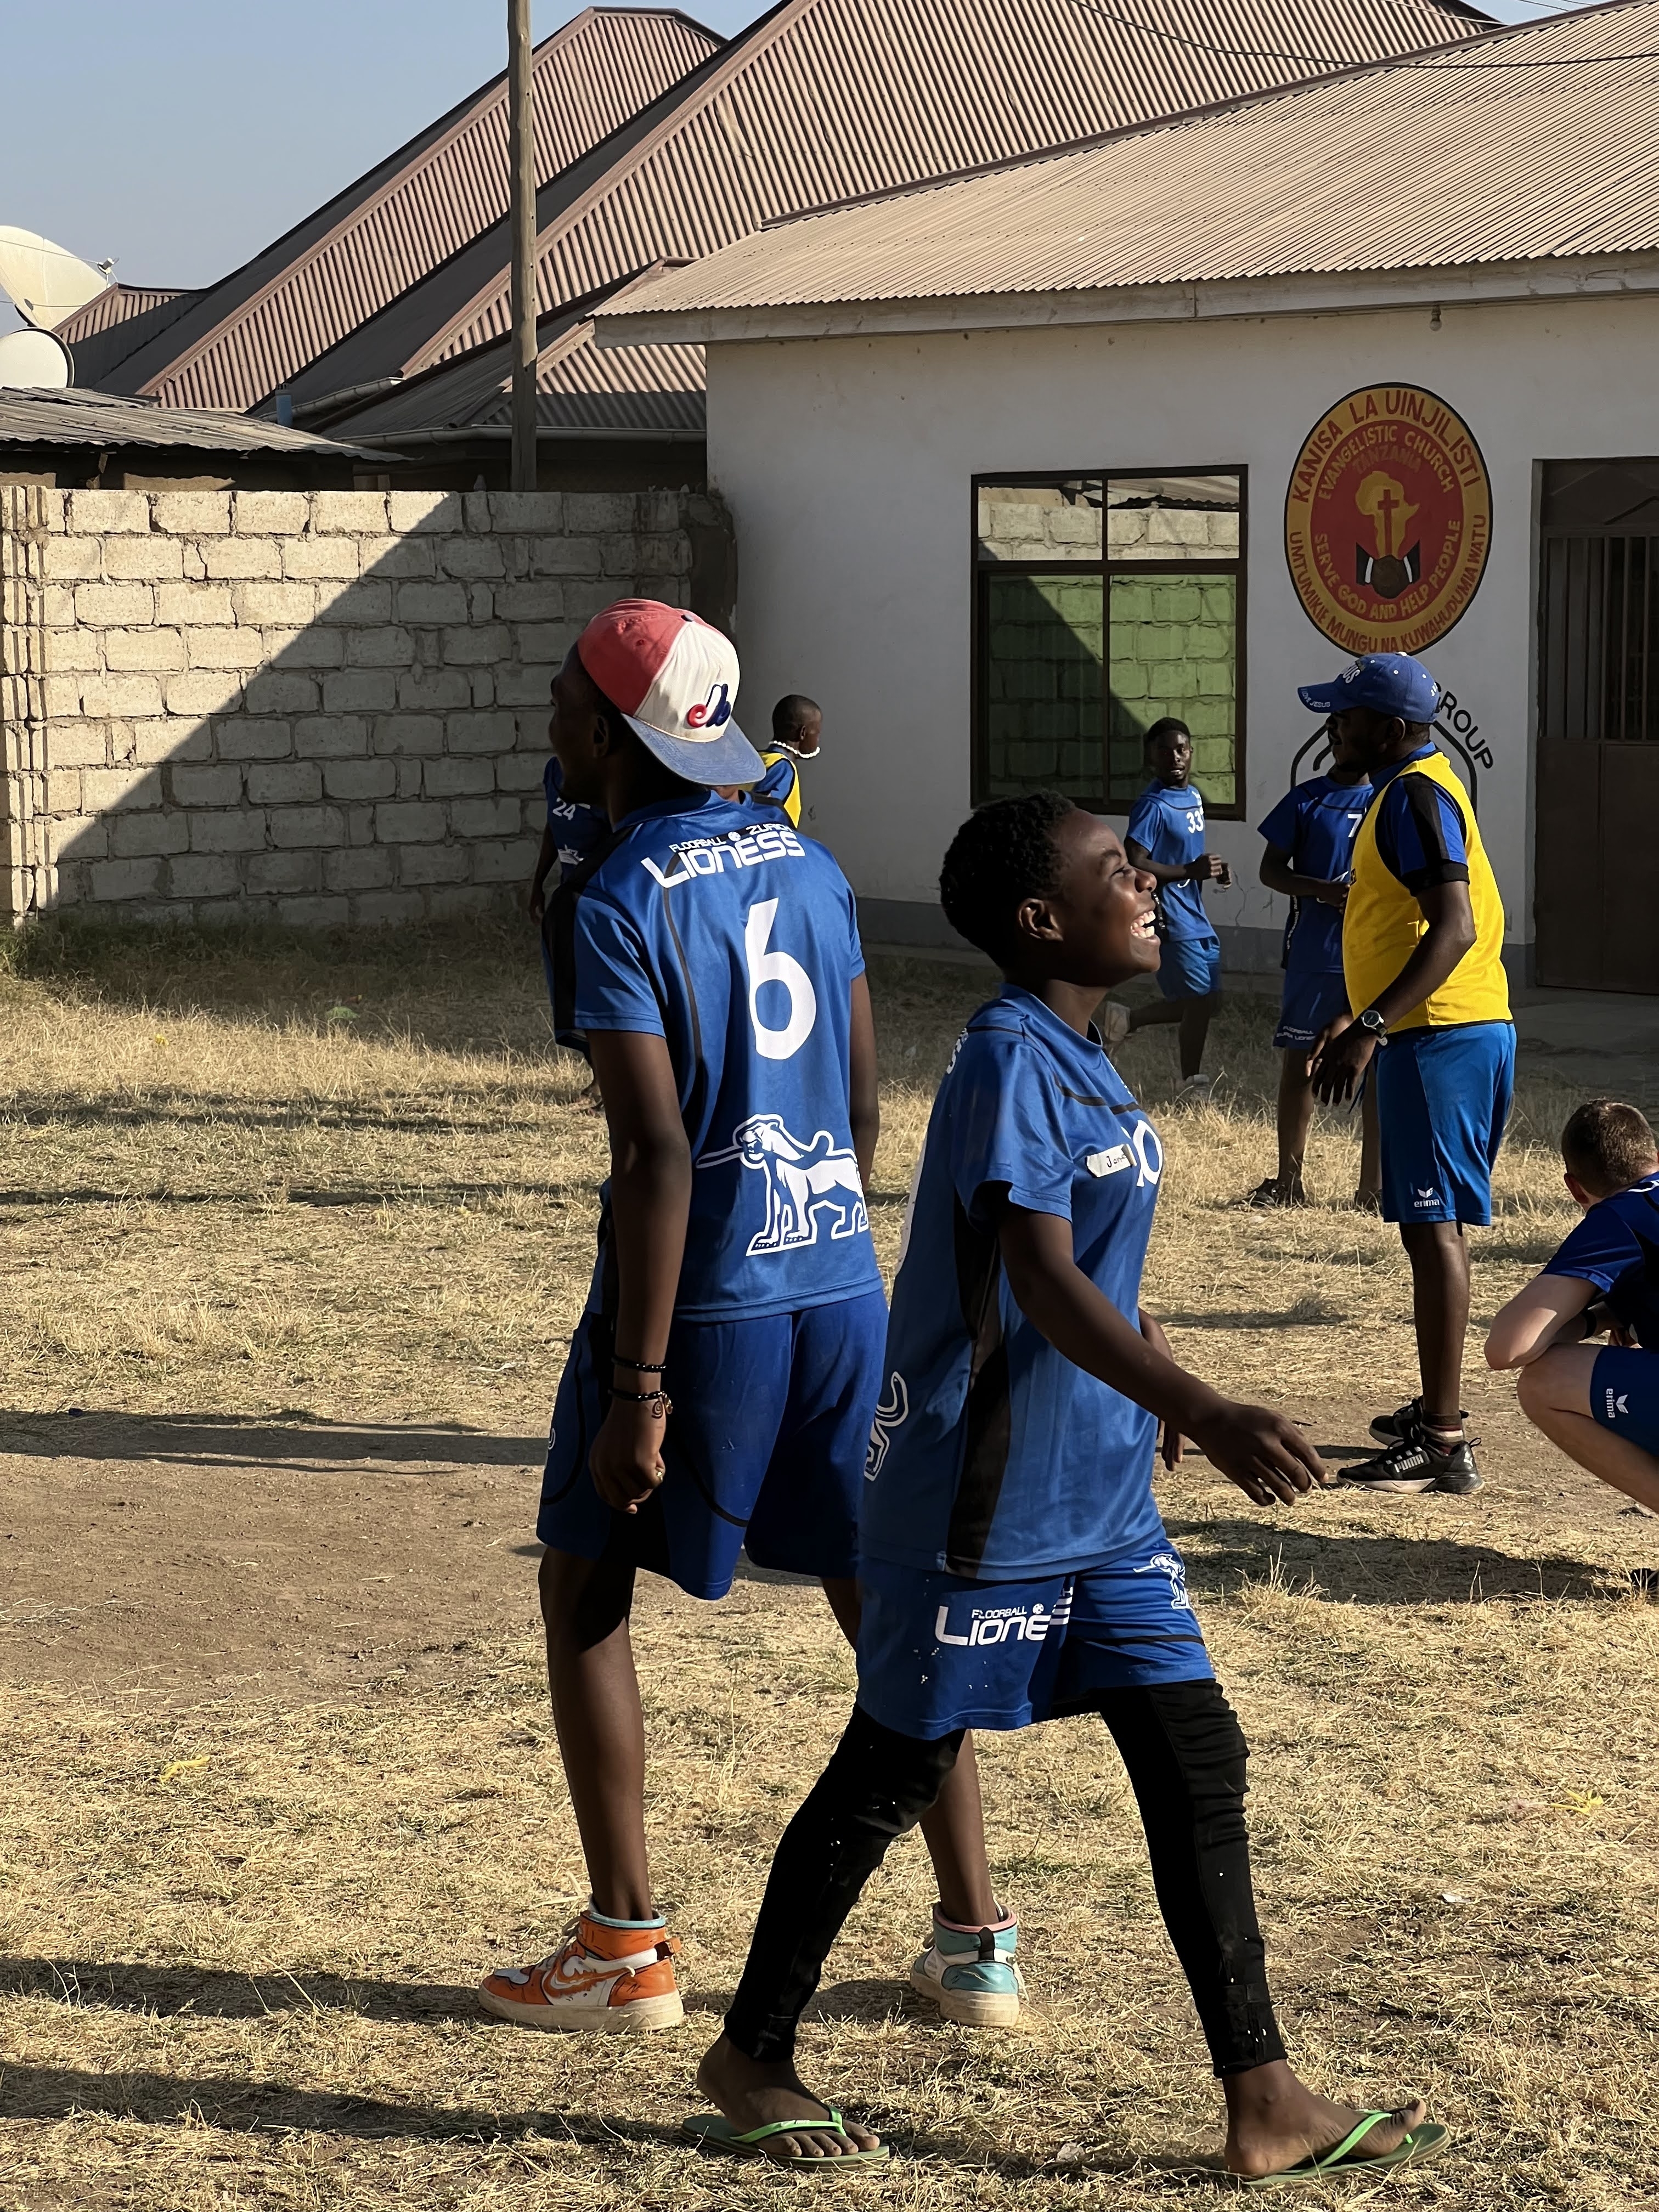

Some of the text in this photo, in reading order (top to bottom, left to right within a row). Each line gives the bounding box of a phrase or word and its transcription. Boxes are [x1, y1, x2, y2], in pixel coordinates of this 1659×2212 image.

[1293, 390, 1481, 503] KANISA LA UINJILISTI
[1318, 426, 1454, 500] EVANGELISTIC CHURCH
[1315, 520, 1460, 619] SERVE GOD AND HELP PEOPLE
[1326, 616, 1377, 653] MUNGU
[1381, 636, 1398, 653] NA
[1468, 515, 1486, 563] WATU
[552, 797, 576, 820] 24
[669, 823, 793, 853] FLOORBALL ZURICH
[745, 898, 816, 1060] 6
[1414, 1199, 1440, 1207] erima
[1606, 1388, 1616, 1418] erima
[972, 1606, 1028, 1619] FLOORBALL
